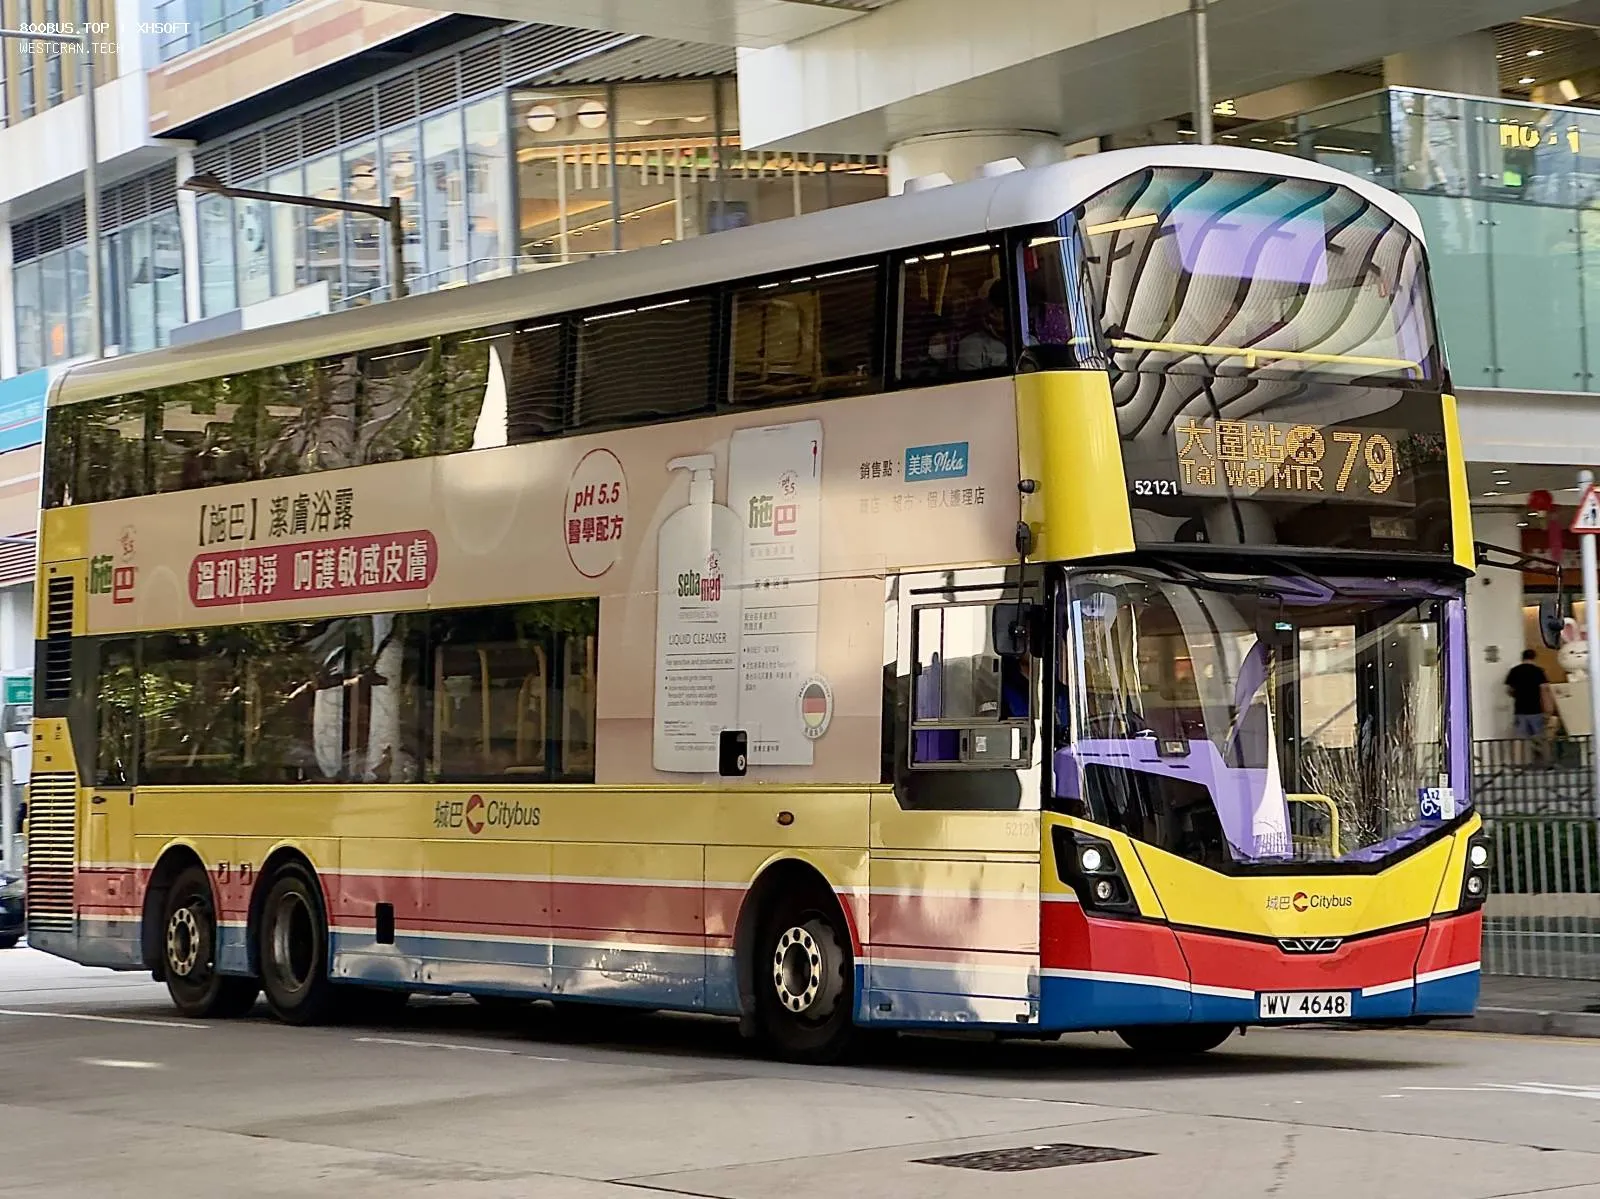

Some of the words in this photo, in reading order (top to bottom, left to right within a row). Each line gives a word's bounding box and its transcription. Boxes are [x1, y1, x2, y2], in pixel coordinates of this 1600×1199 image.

[1177, 418, 1285, 464] 大圍站
[909, 455, 933, 475] 美康
[1179, 459, 1216, 485] Tai
[1224, 461, 1266, 487] Wai
[1273, 464, 1324, 491] MTR
[1333, 431, 1395, 493] 79
[573, 485, 594, 513] pH
[597, 481, 620, 504] 5.5
[1135, 480, 1178, 496] 52121
[568, 514, 624, 544] 醫學配方
[749, 495, 797, 536] 施巴
[293, 539, 428, 591] 呵護敏感皮膚
[668, 633, 691, 646] LIQUID
[693, 632, 727, 645] CLEANSER
[433, 801, 463, 828] 城巴
[487, 800, 541, 828] Citybus
[1266, 895, 1291, 911] 城巴
[1310, 894, 1353, 909] Citybus
[1267, 995, 1290, 1014] WV
[1299, 995, 1346, 1015] 4648
